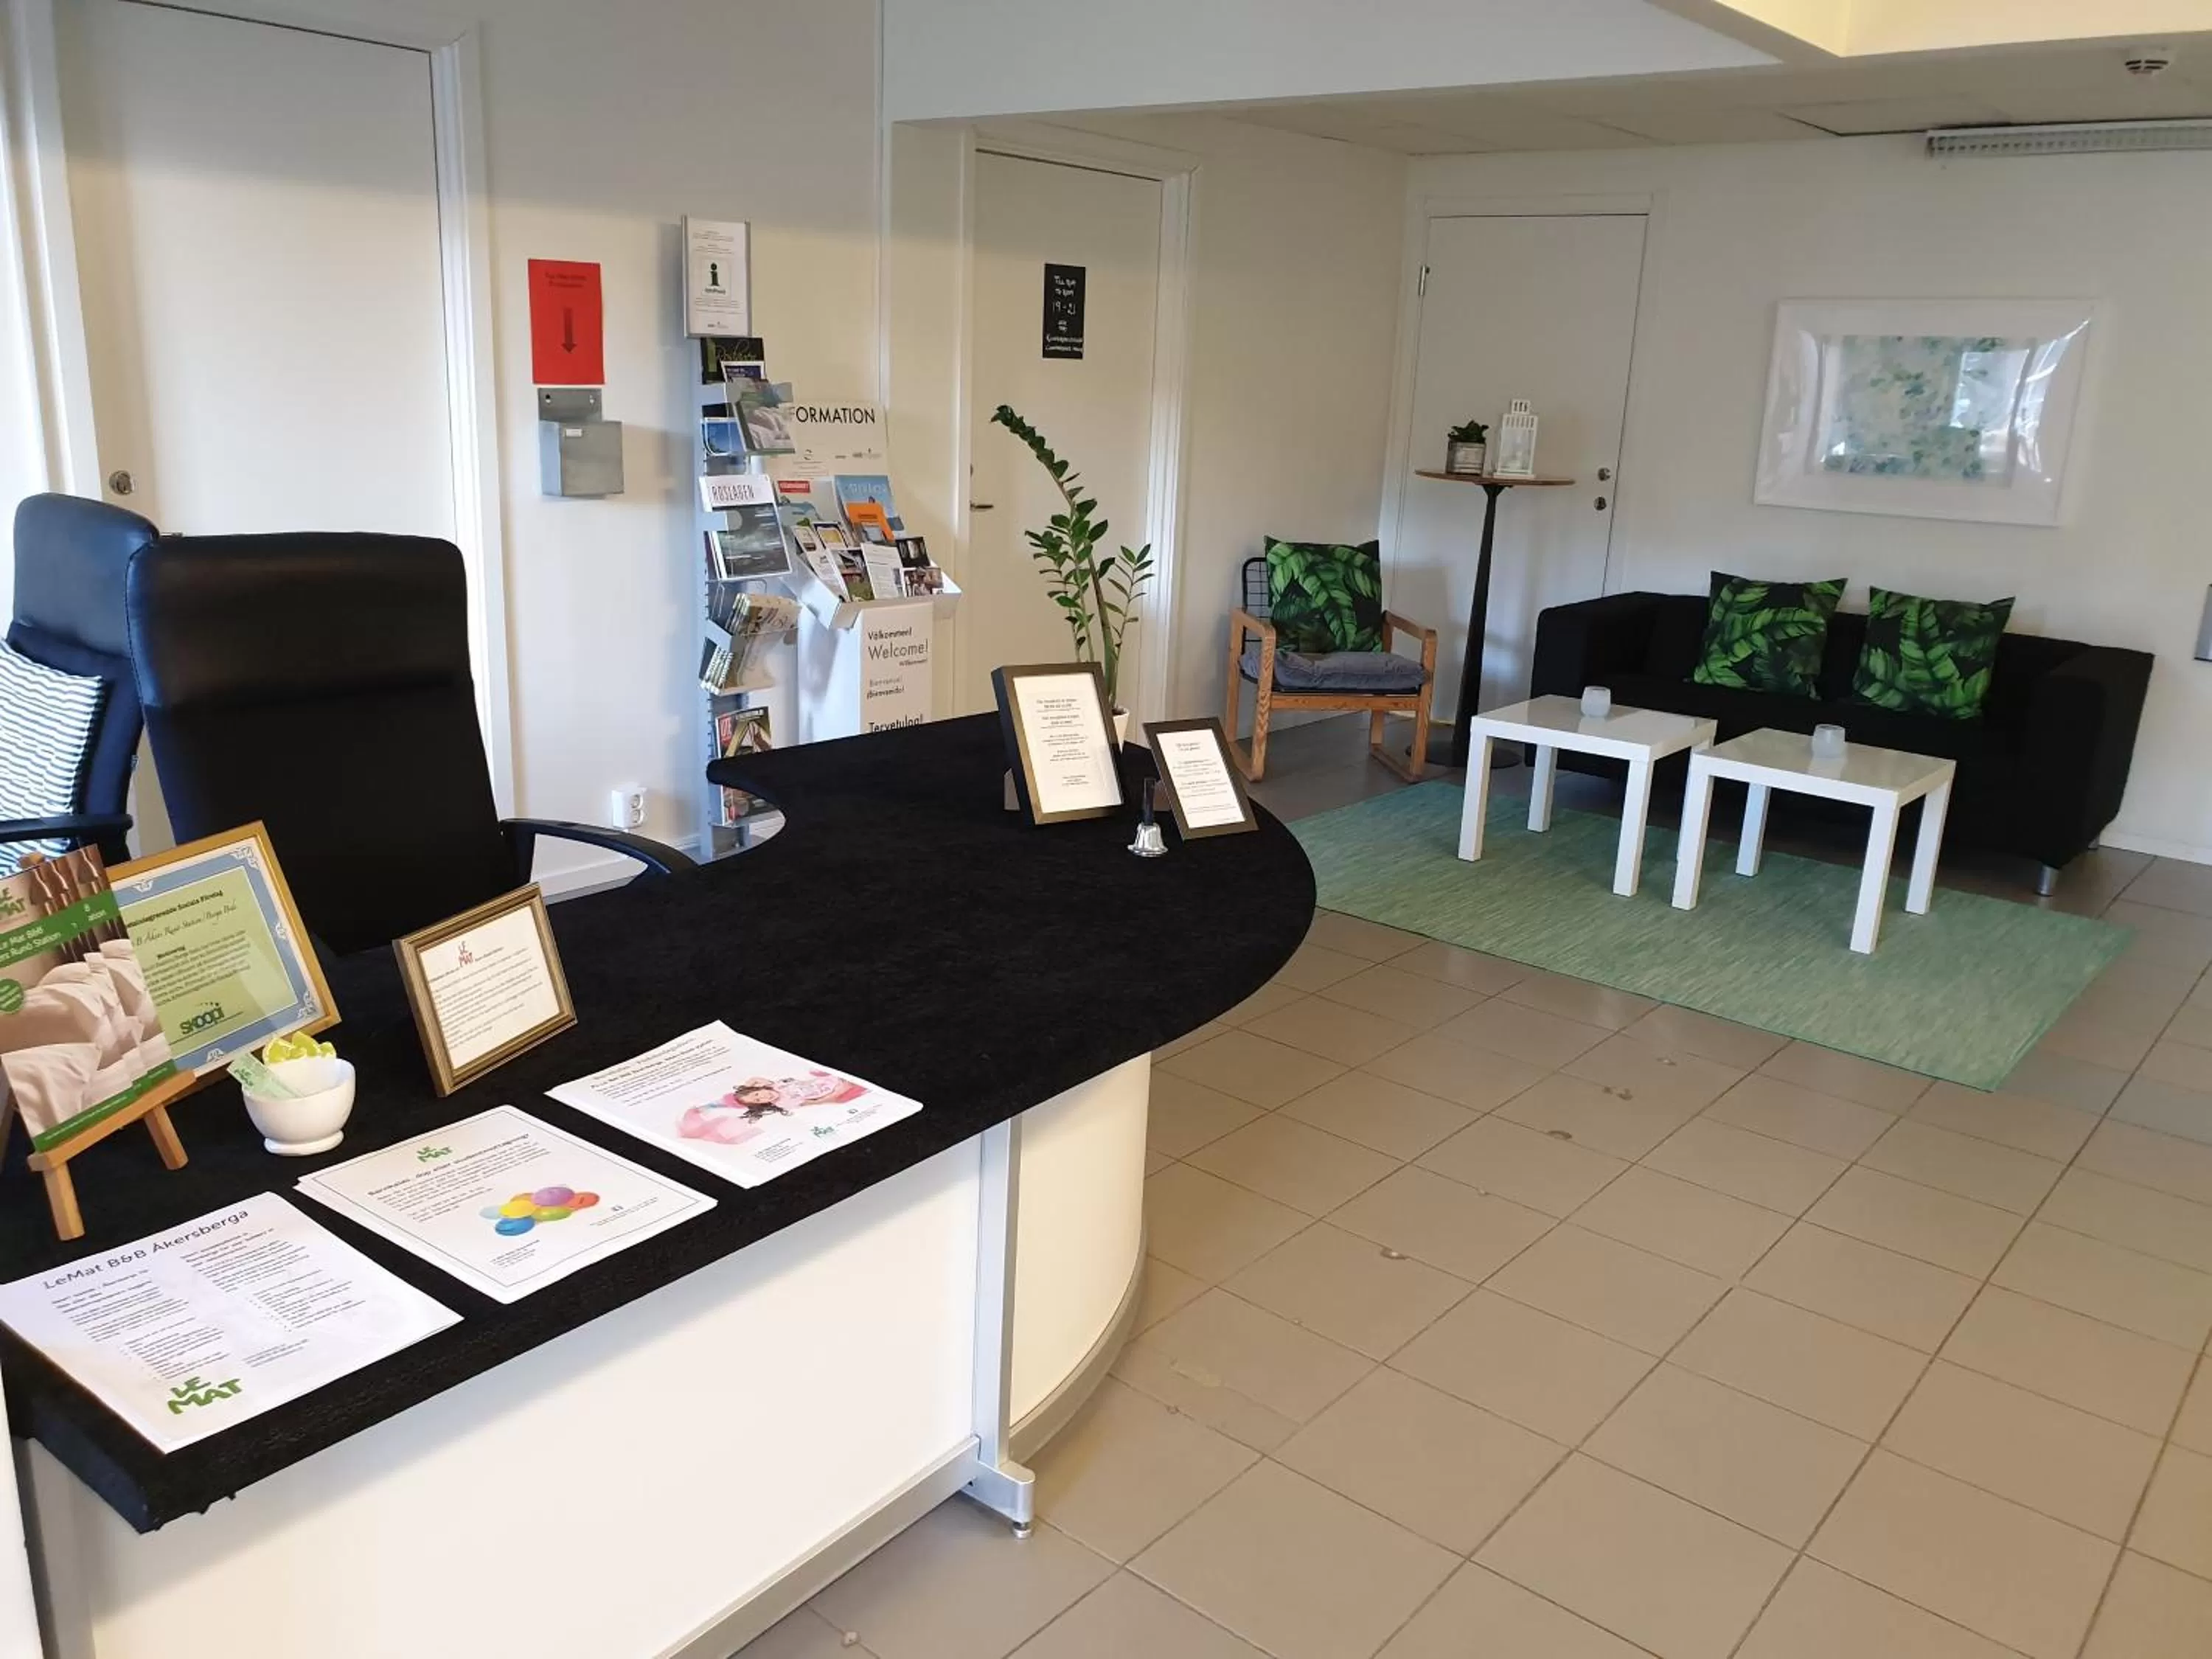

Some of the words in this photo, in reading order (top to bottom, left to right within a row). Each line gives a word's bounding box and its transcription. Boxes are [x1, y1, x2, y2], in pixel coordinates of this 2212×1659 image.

[868, 639, 928, 661] Welcome!
[44, 1264, 107, 1290] LeMat
[108, 1249, 147, 1267] B&B
[152, 1210, 248, 1253] Åkersberga
[167, 1378, 243, 1414] MAT
[170, 1376, 211, 1398] LE
